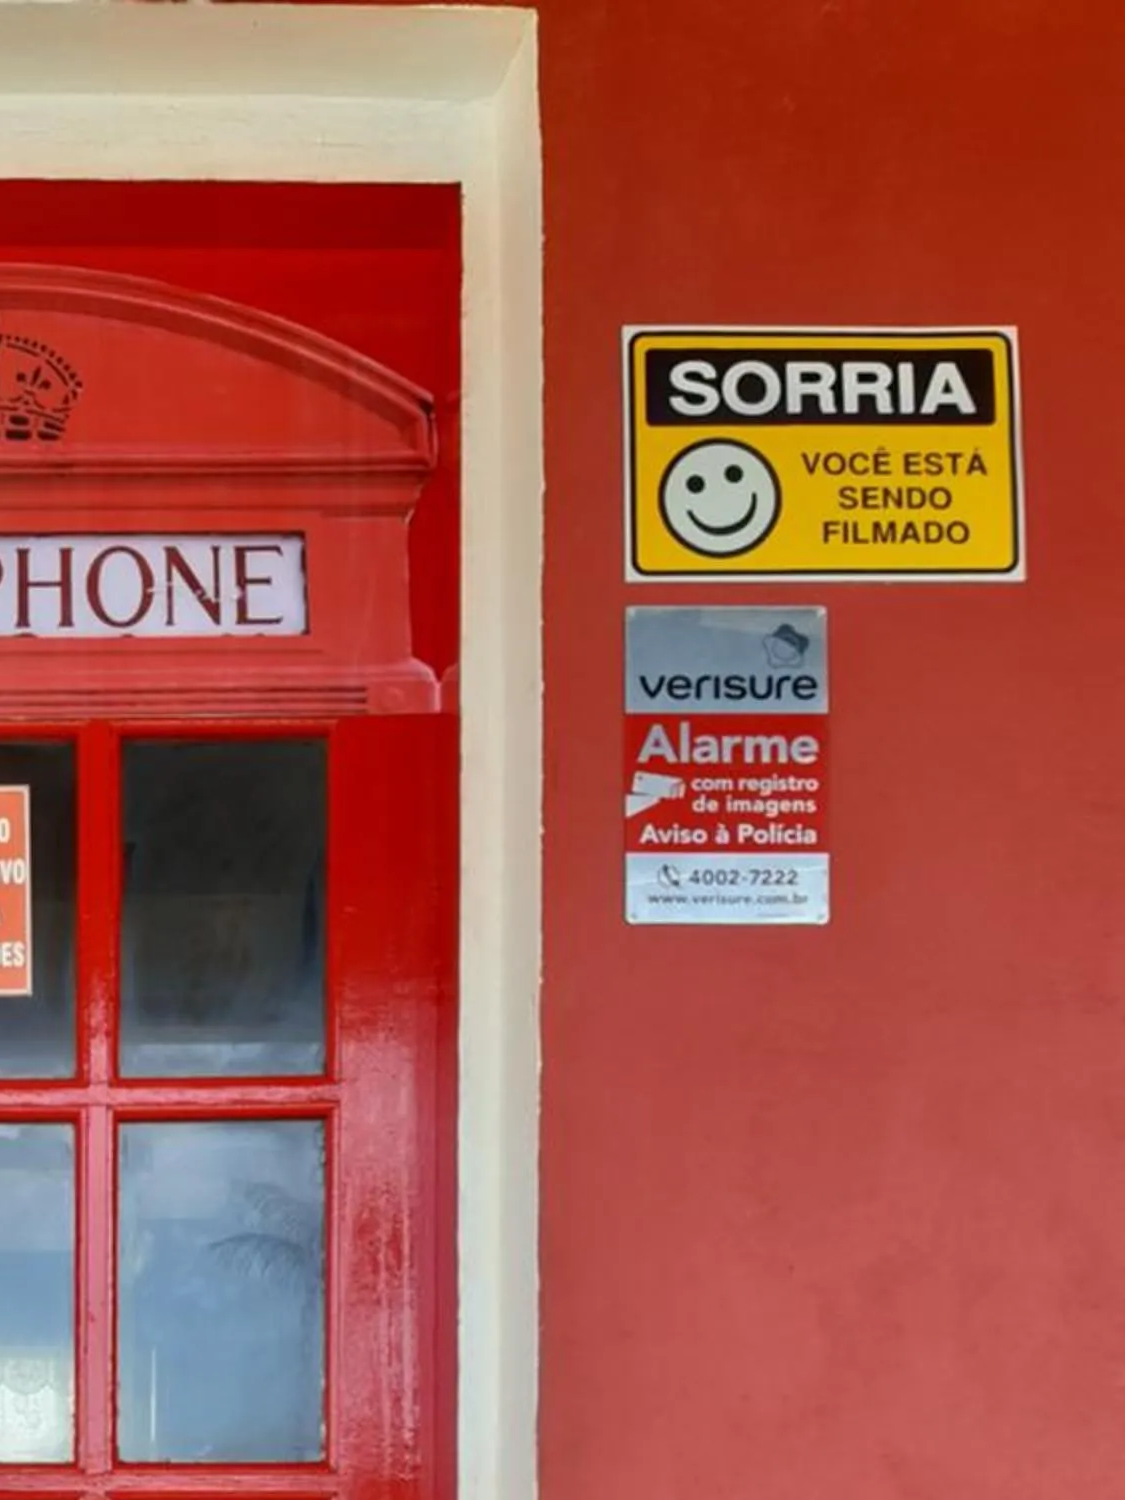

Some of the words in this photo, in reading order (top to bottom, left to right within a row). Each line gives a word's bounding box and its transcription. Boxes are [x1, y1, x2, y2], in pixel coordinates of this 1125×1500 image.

[669, 360, 976, 416] SORRIA
[801, 448, 892, 476] VOCÊ
[904, 448, 987, 476] ESTÁ
[838, 487, 952, 510] SENDO
[823, 520, 970, 545] FILMADO
[639, 674, 818, 701] verisure
[637, 721, 819, 764] Alarme
[691, 776, 733, 792] com
[738, 774, 819, 797] registro
[691, 795, 719, 813] de
[726, 795, 817, 818] imagens
[639, 824, 708, 845] Aviso
[715, 824, 730, 845] à
[737, 823, 817, 845] Polícia
[688, 868, 799, 886] 4002-7222
[647, 892, 809, 905] www.verisure.com.br
